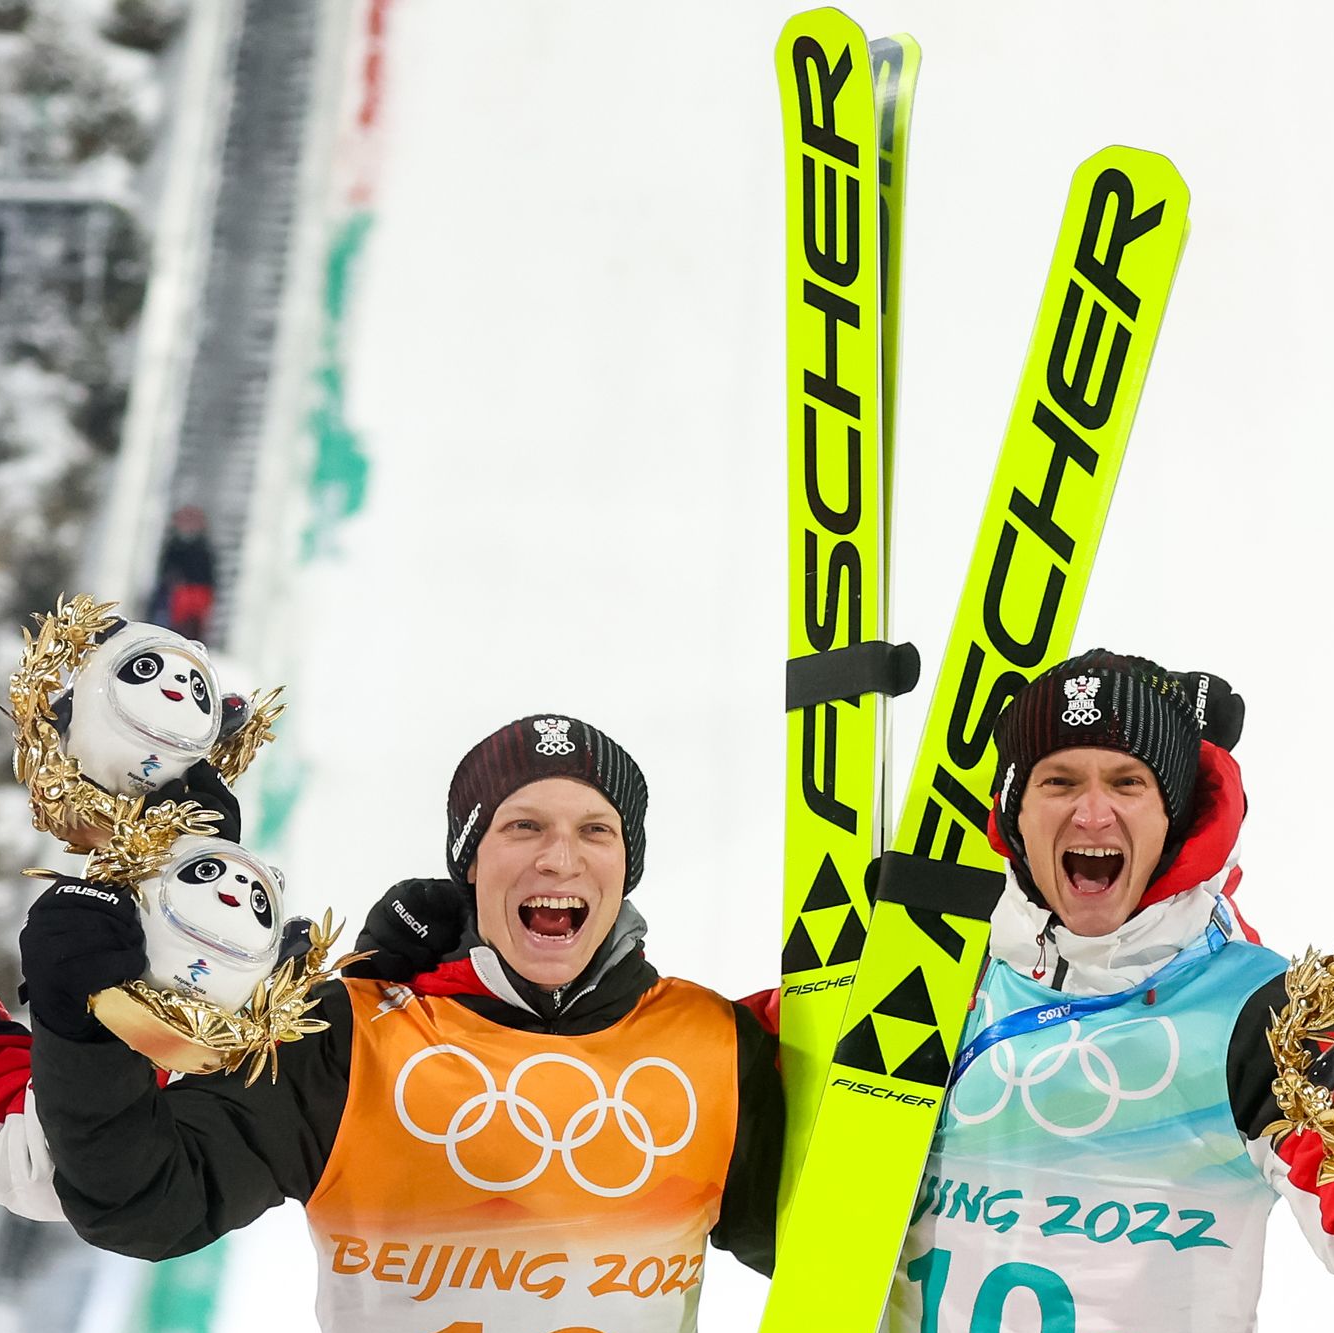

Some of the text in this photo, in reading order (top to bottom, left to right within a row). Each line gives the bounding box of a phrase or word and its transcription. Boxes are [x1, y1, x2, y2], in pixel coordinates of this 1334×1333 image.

[792, 36, 861, 835] FSCHER
[55, 884, 120, 905] reusch
[391, 899, 430, 939] reusch
[831, 1078, 937, 1109] FISCHER
[910, 1173, 1232, 1251] JING 2022
[328, 1232, 703, 1302] BEIJING 2022
